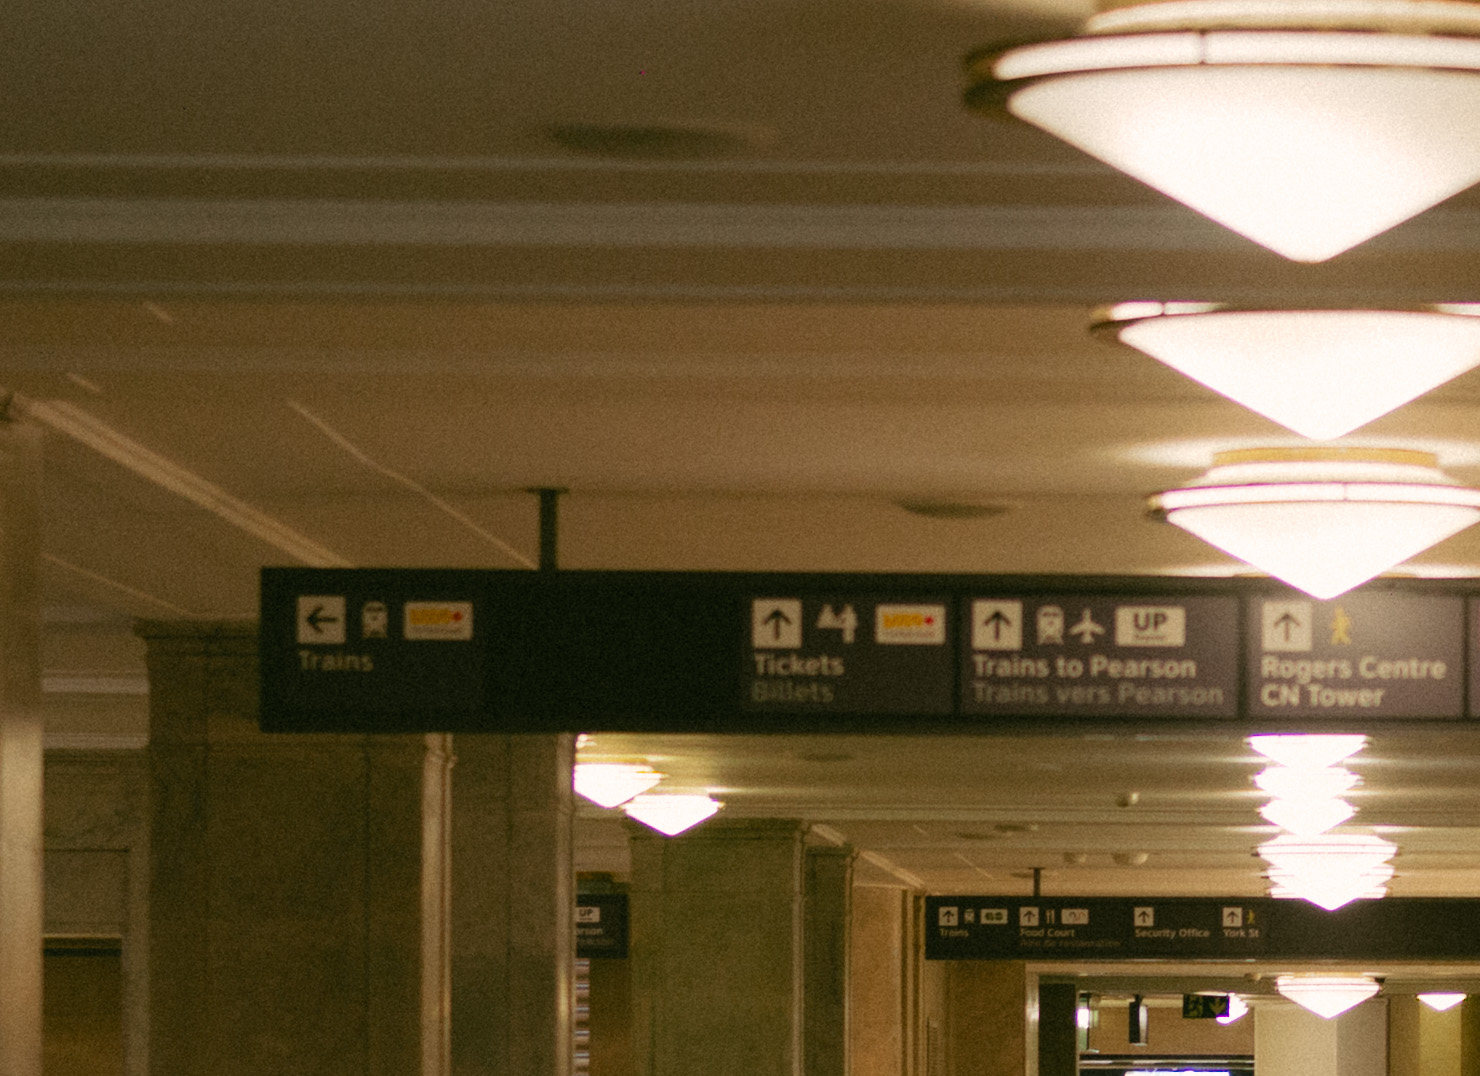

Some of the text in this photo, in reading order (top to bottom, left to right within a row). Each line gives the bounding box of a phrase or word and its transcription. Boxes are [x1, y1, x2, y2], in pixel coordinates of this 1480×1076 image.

[1133, 612, 1168, 632] UP
[298, 650, 374, 672] Trains
[754, 653, 845, 676] Tickets
[973, 654, 1197, 678] Trains to Pearson
[1261, 656, 1447, 683] Rogers Centre
[752, 681, 834, 703] Billets
[973, 681, 1223, 705] Trains vers Pearson
[1261, 684, 1385, 707] CN Tower
[939, 928, 969, 938] Trains
[1020, 928, 1075, 938] Food Court
[1135, 928, 1211, 940] Security Office
[1223, 929, 1259, 938] York St
